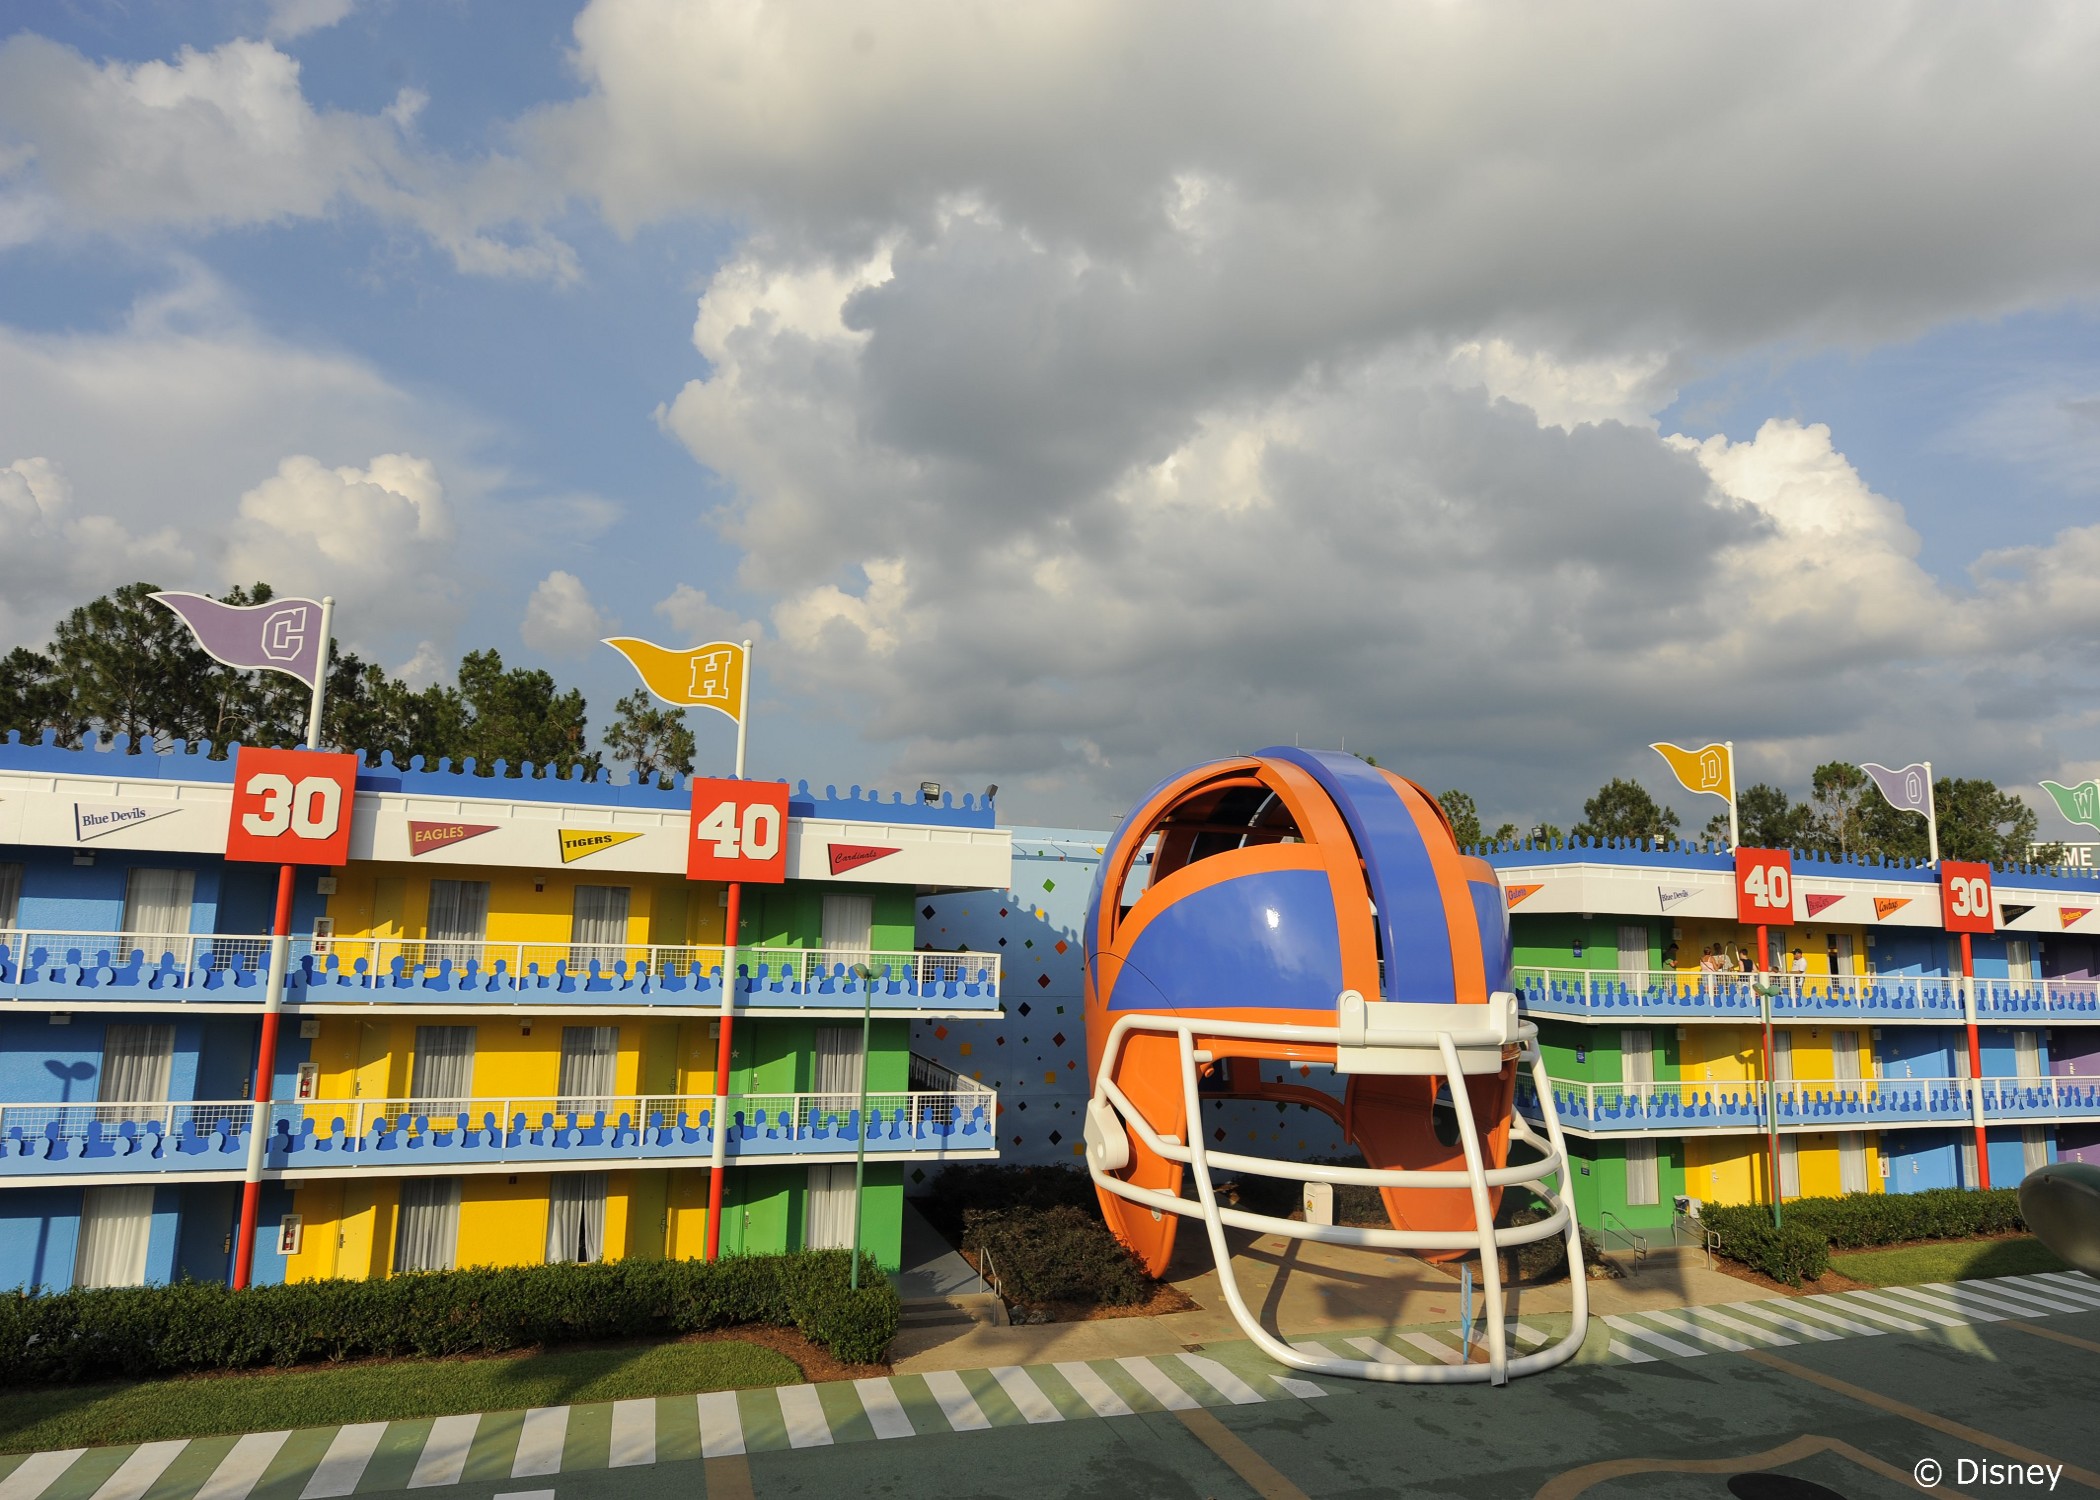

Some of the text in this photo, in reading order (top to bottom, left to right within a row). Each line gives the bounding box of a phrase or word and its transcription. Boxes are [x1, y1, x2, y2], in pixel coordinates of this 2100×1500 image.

[261, 607, 307, 661] C
[688, 650, 732, 699] H
[1700, 750, 1722, 788] D
[82, 807, 146, 827] Blue Devils
[242, 773, 342, 840] 30
[2073, 786, 2093, 819] W
[415, 826, 464, 842] EAGLES
[564, 835, 613, 848] TIGERS
[697, 801, 781, 860] 40
[835, 849, 877, 864] Cardinals
[1744, 864, 1790, 908] 40
[1950, 876, 1989, 918] 30
